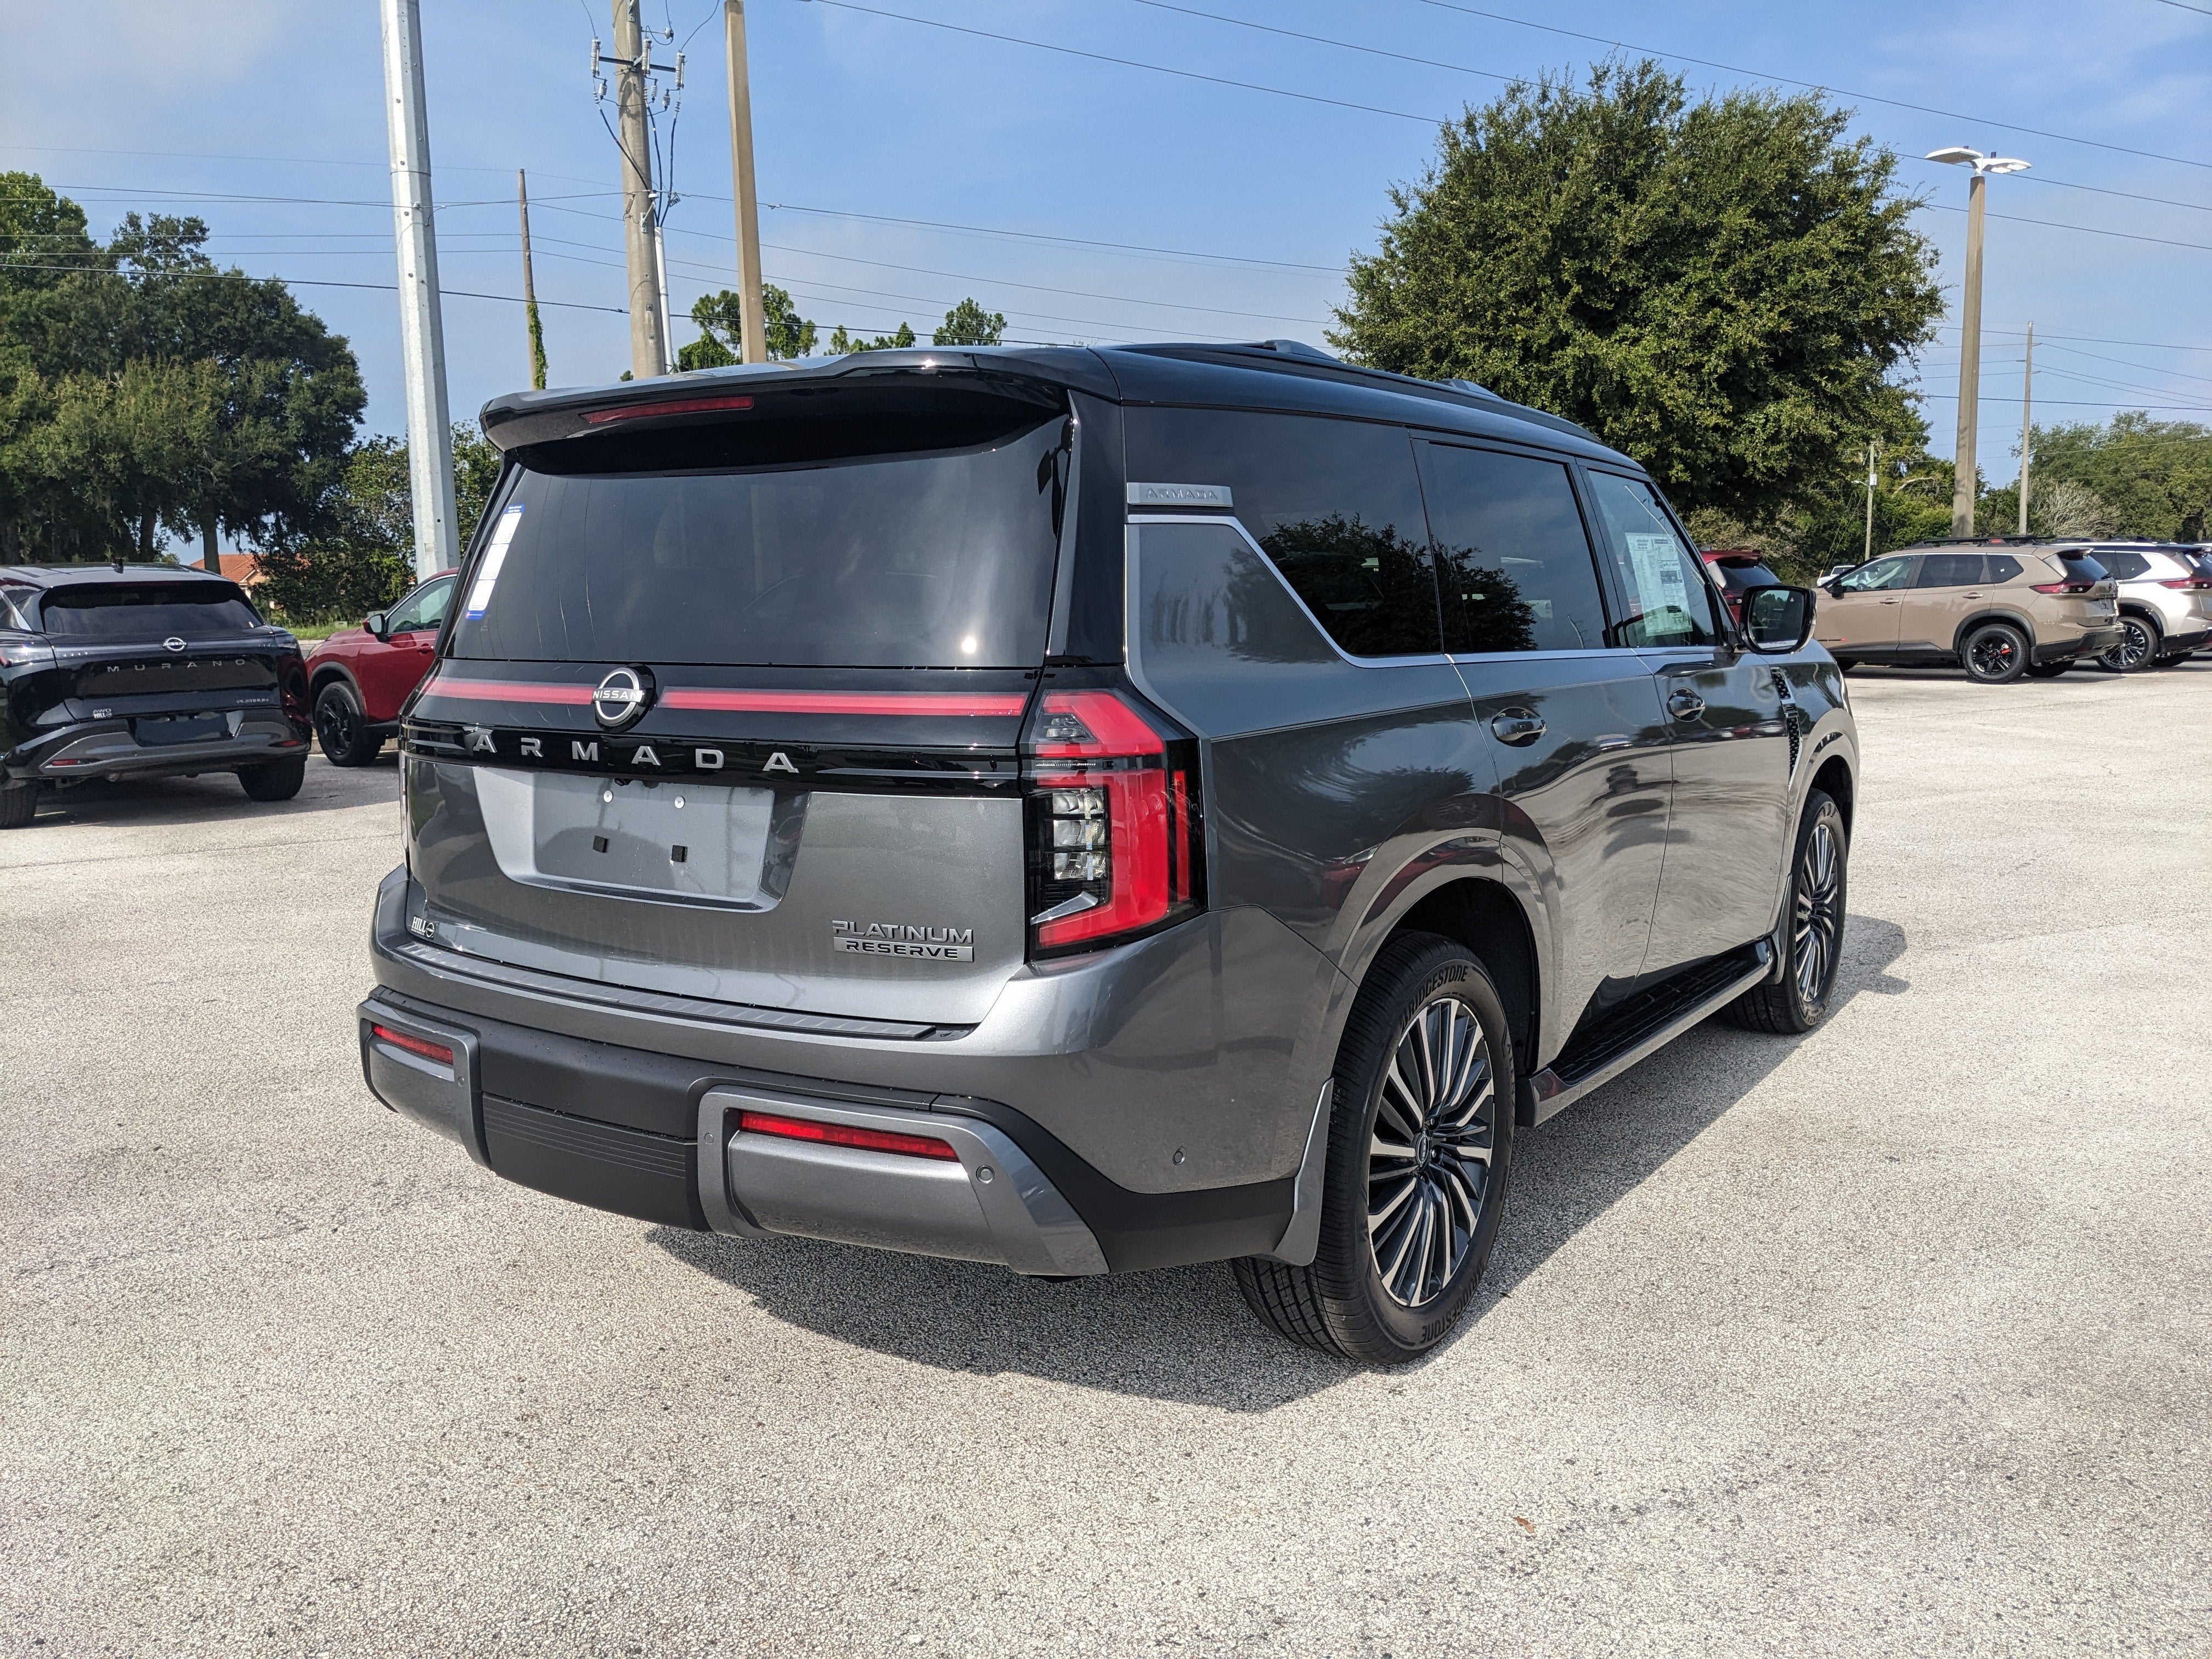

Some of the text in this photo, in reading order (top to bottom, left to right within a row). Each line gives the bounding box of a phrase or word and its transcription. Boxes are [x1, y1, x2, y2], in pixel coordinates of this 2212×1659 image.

[1147, 488, 1218, 500] ARMADA
[106, 659, 246, 673] MURANO
[592, 690, 638, 699] NISSAN
[473, 735, 799, 774] ARMADA
[411, 916, 427, 933] HILL
[832, 920, 974, 944] PLATINUM
[846, 940, 958, 959] RESERVE
[1400, 964, 1469, 1036] BRIDGESTONE
